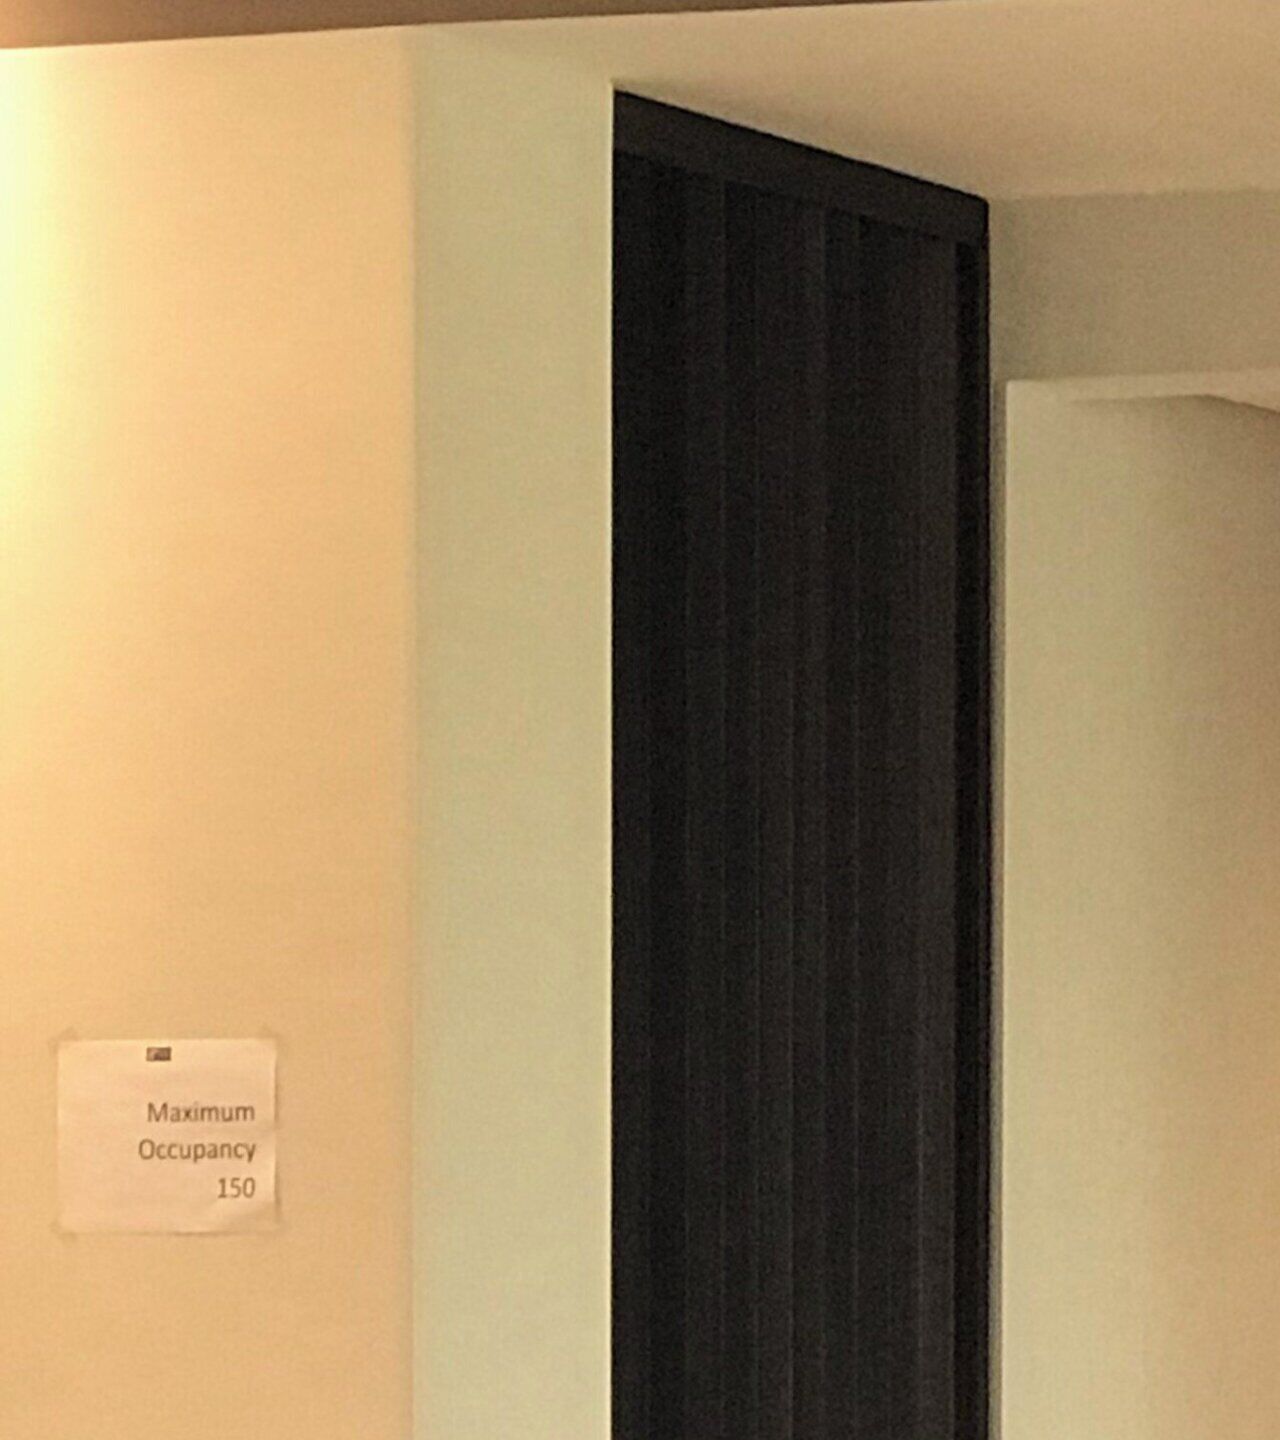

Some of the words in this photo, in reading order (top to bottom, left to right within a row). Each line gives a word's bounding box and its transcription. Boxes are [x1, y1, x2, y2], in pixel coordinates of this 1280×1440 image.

[147, 1102, 255, 1123] Maximum
[138, 1138, 256, 1164] Occupancy
[217, 1176, 256, 1199] 150
